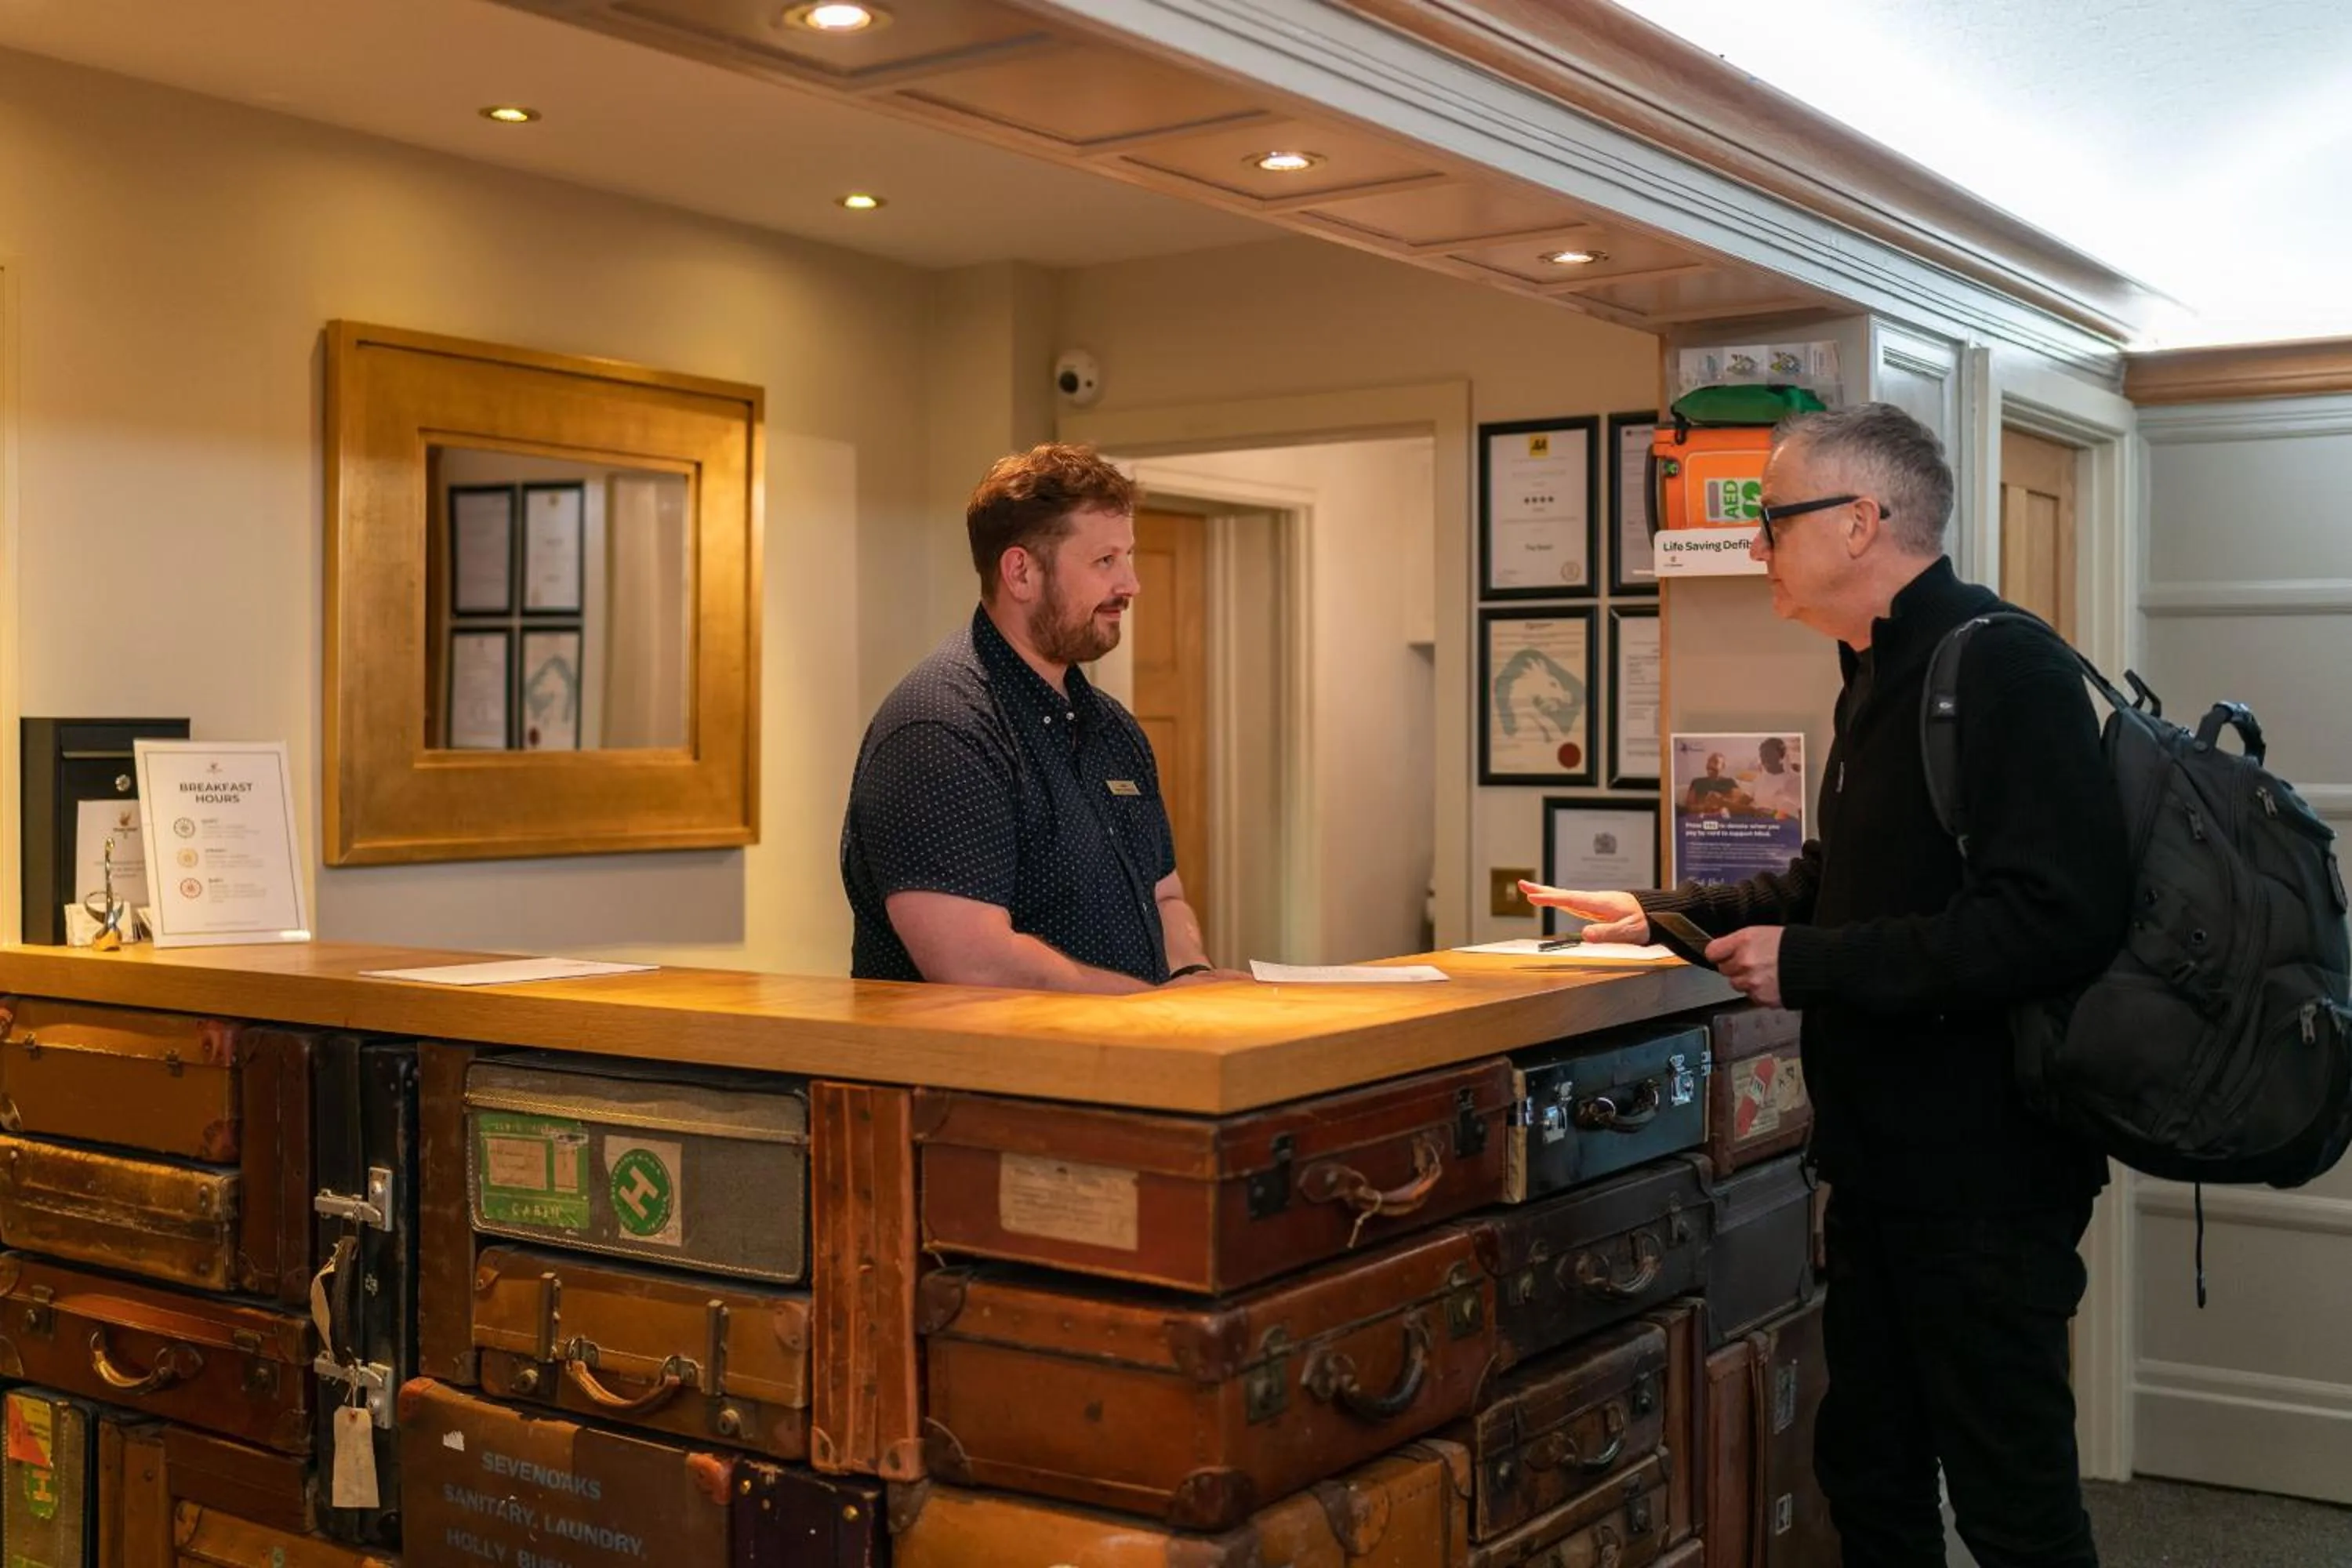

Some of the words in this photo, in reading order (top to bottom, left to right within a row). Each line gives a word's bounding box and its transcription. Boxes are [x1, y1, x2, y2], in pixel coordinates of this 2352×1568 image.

[1723, 480, 1739, 519] AED
[1663, 541, 1684, 552] Life
[1686, 541, 1722, 552] Saving
[180, 782, 253, 793] BREAKFAST
[195, 794, 241, 804] HOURS
[481, 1451, 602, 1501] SEVENOAKS
[443, 1483, 536, 1526] SANITARY
[446, 1528, 506, 1563] HOLLY
